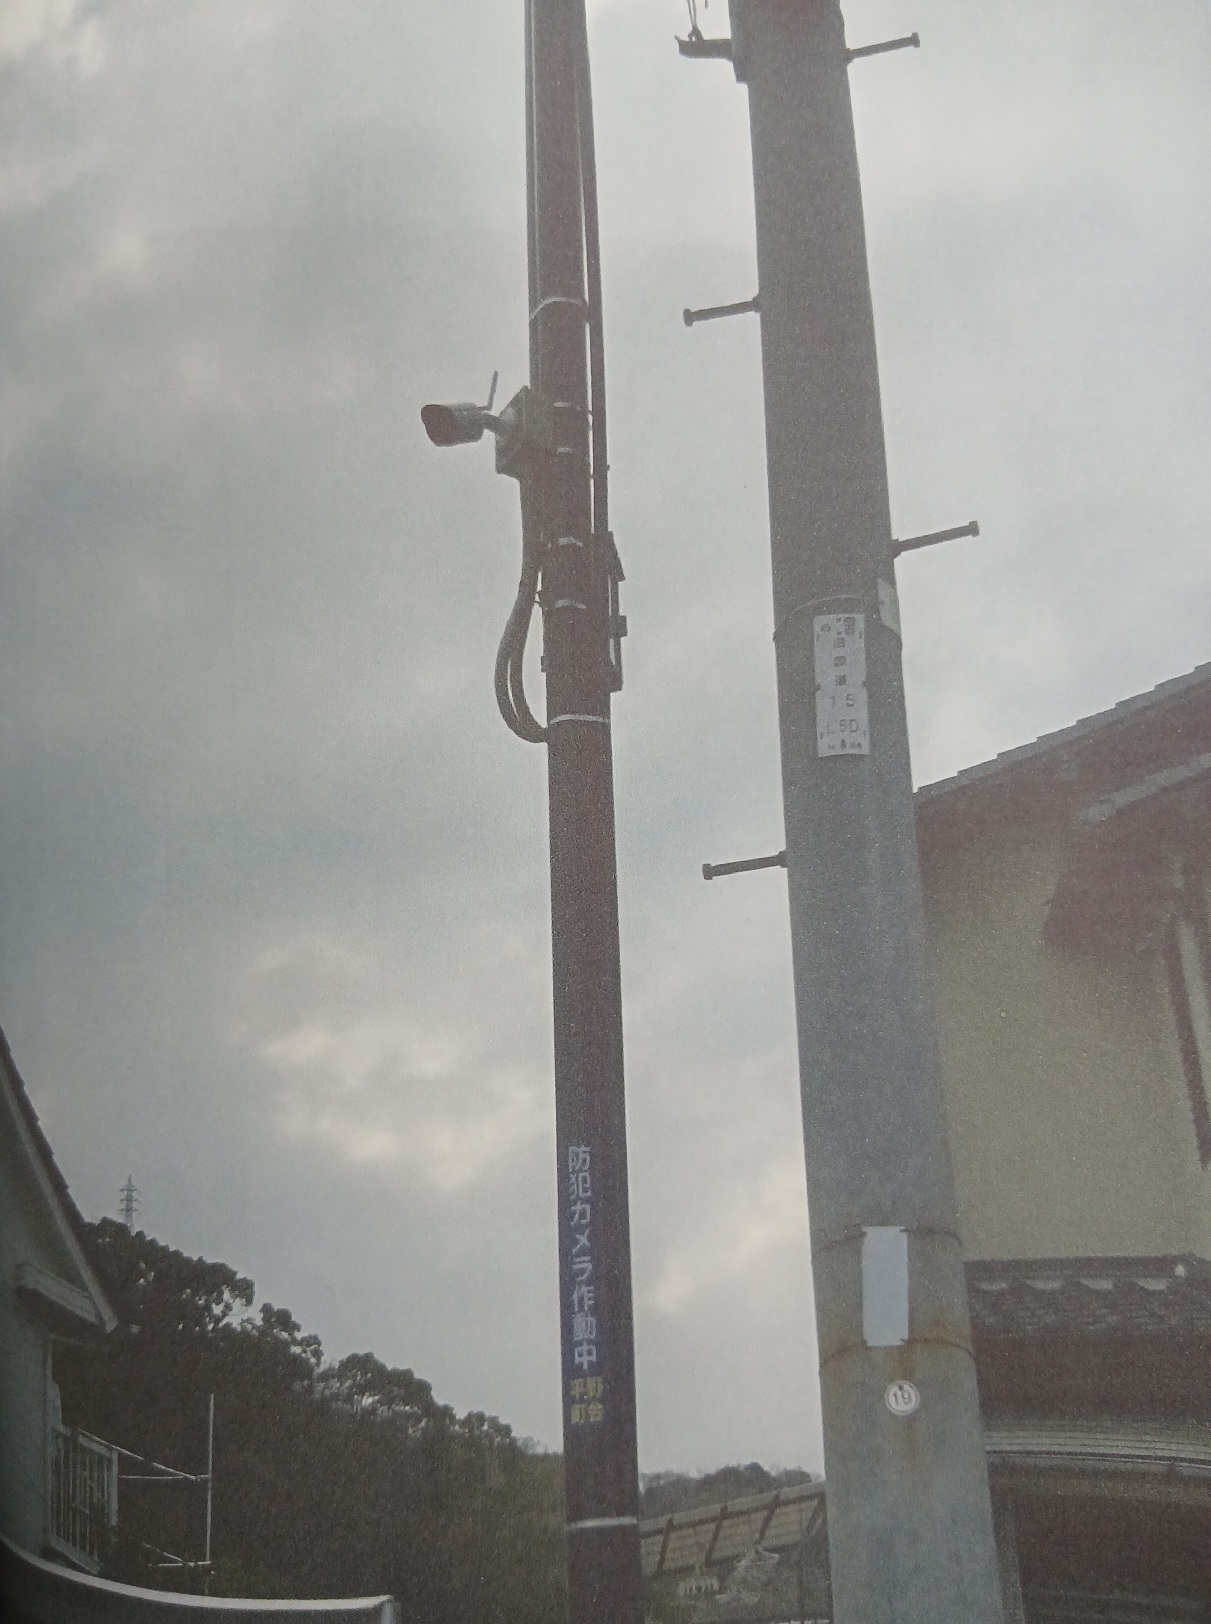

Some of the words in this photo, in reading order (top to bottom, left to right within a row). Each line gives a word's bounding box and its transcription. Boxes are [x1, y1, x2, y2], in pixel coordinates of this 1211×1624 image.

[568, 1143, 597, 1370] 防犯カメラ作動中
[892, 1389, 912, 1406] 19
